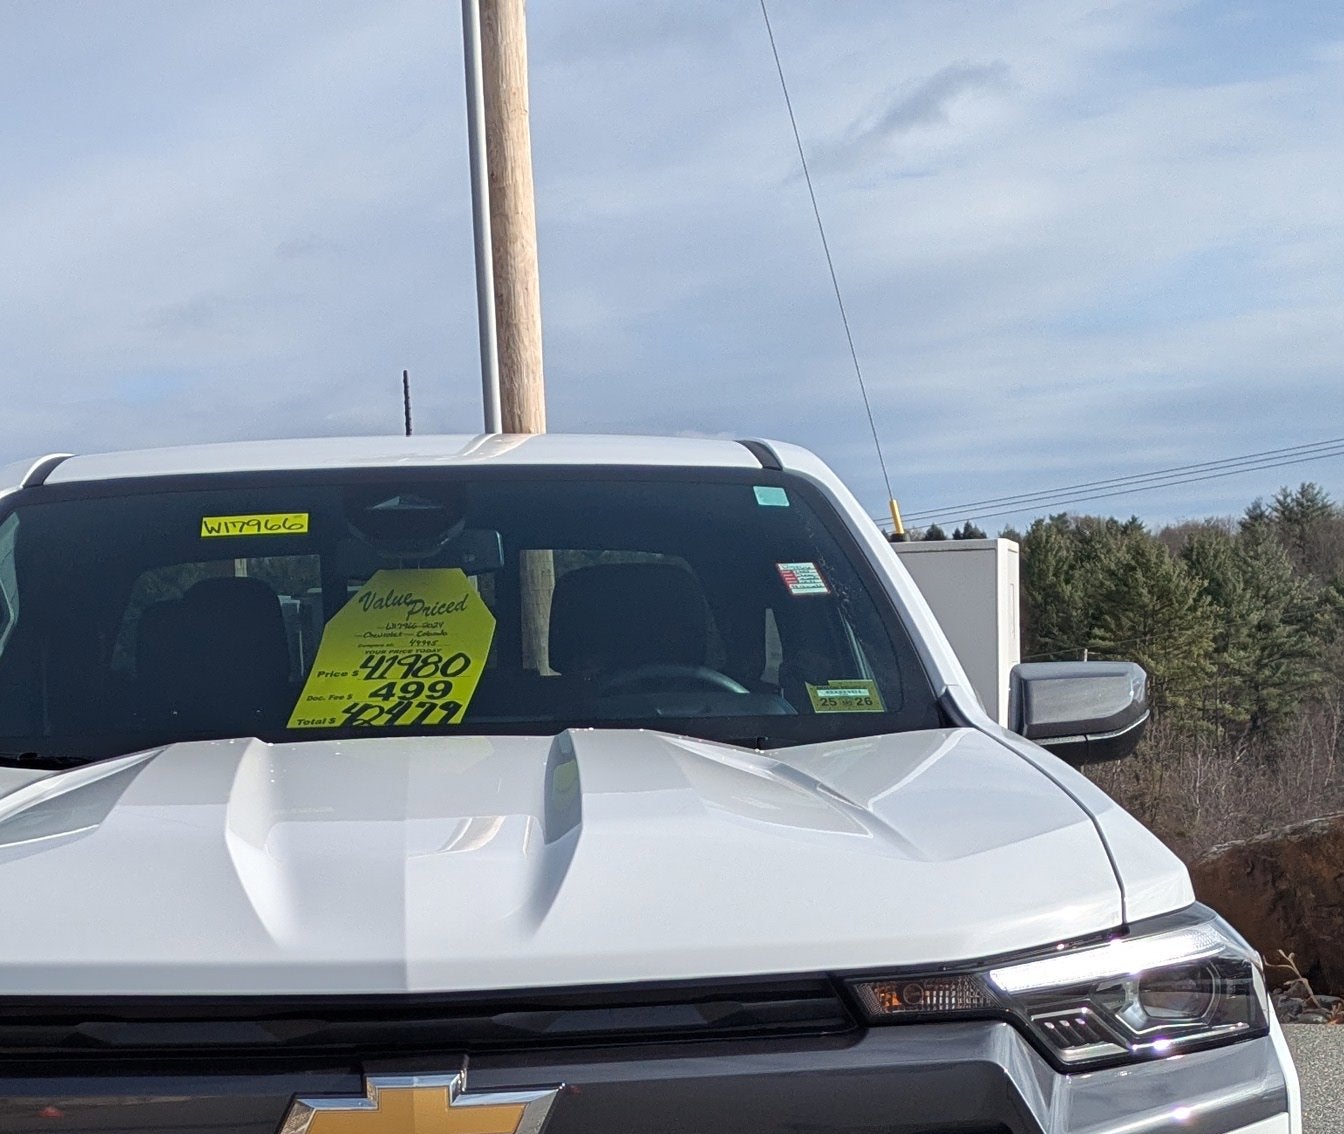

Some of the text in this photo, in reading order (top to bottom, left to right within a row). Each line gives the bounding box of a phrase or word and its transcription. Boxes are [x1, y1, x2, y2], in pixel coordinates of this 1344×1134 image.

[203, 517, 305, 534] W17966
[358, 589, 469, 619] Value Priced
[317, 652, 471, 680] Price $ 41980
[368, 680, 454, 701] 499
[820, 697, 837, 707] 25
[855, 697, 873, 706] 26
[297, 718, 325, 726] Total
[325, 717, 336, 725] $
